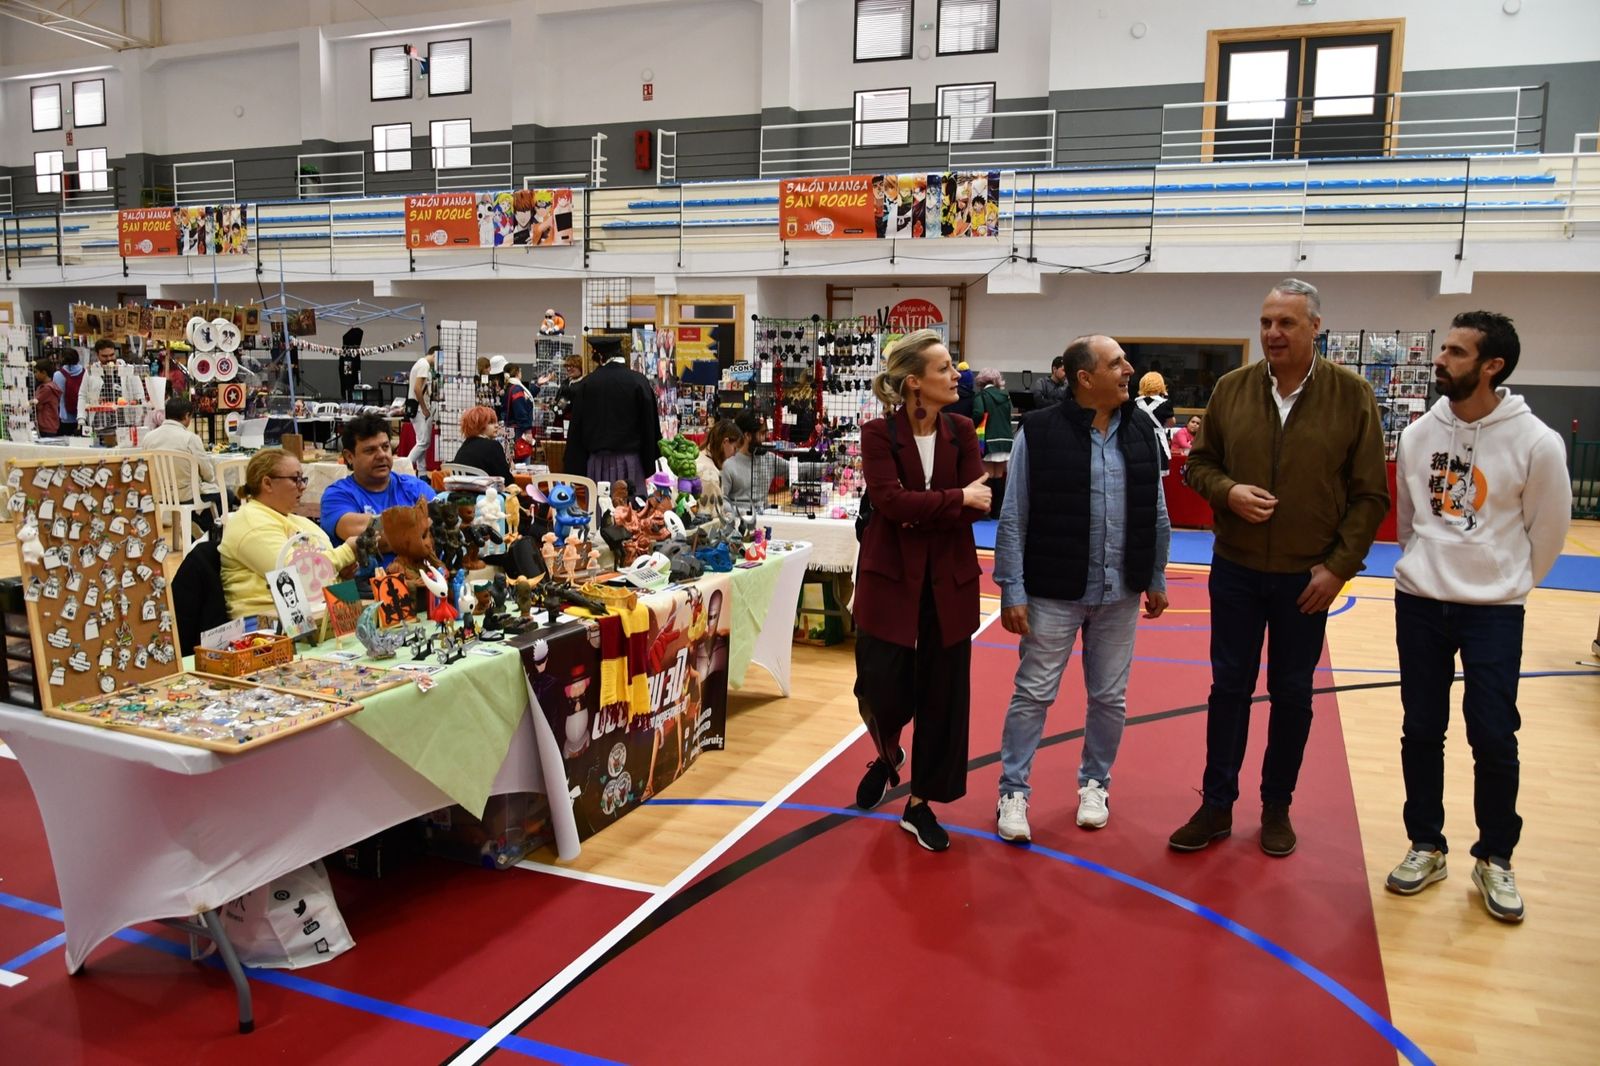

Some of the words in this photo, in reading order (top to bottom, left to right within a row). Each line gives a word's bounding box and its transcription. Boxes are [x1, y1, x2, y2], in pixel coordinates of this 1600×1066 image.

[787, 179, 824, 193] SALÓN
[828, 180, 868, 192] MANGA
[410, 196, 441, 208] SALÓN
[442, 197, 473, 207] MANGA
[785, 195, 815, 209] SAN
[818, 193, 868, 208] ROQUE
[122, 209, 146, 220] SALÓN
[147, 210, 172, 219] MANGA
[409, 209, 432, 222] SAN
[435, 208, 472, 221] ROQUE
[122, 221, 140, 233] SAN
[142, 220, 172, 232] ROQUE
